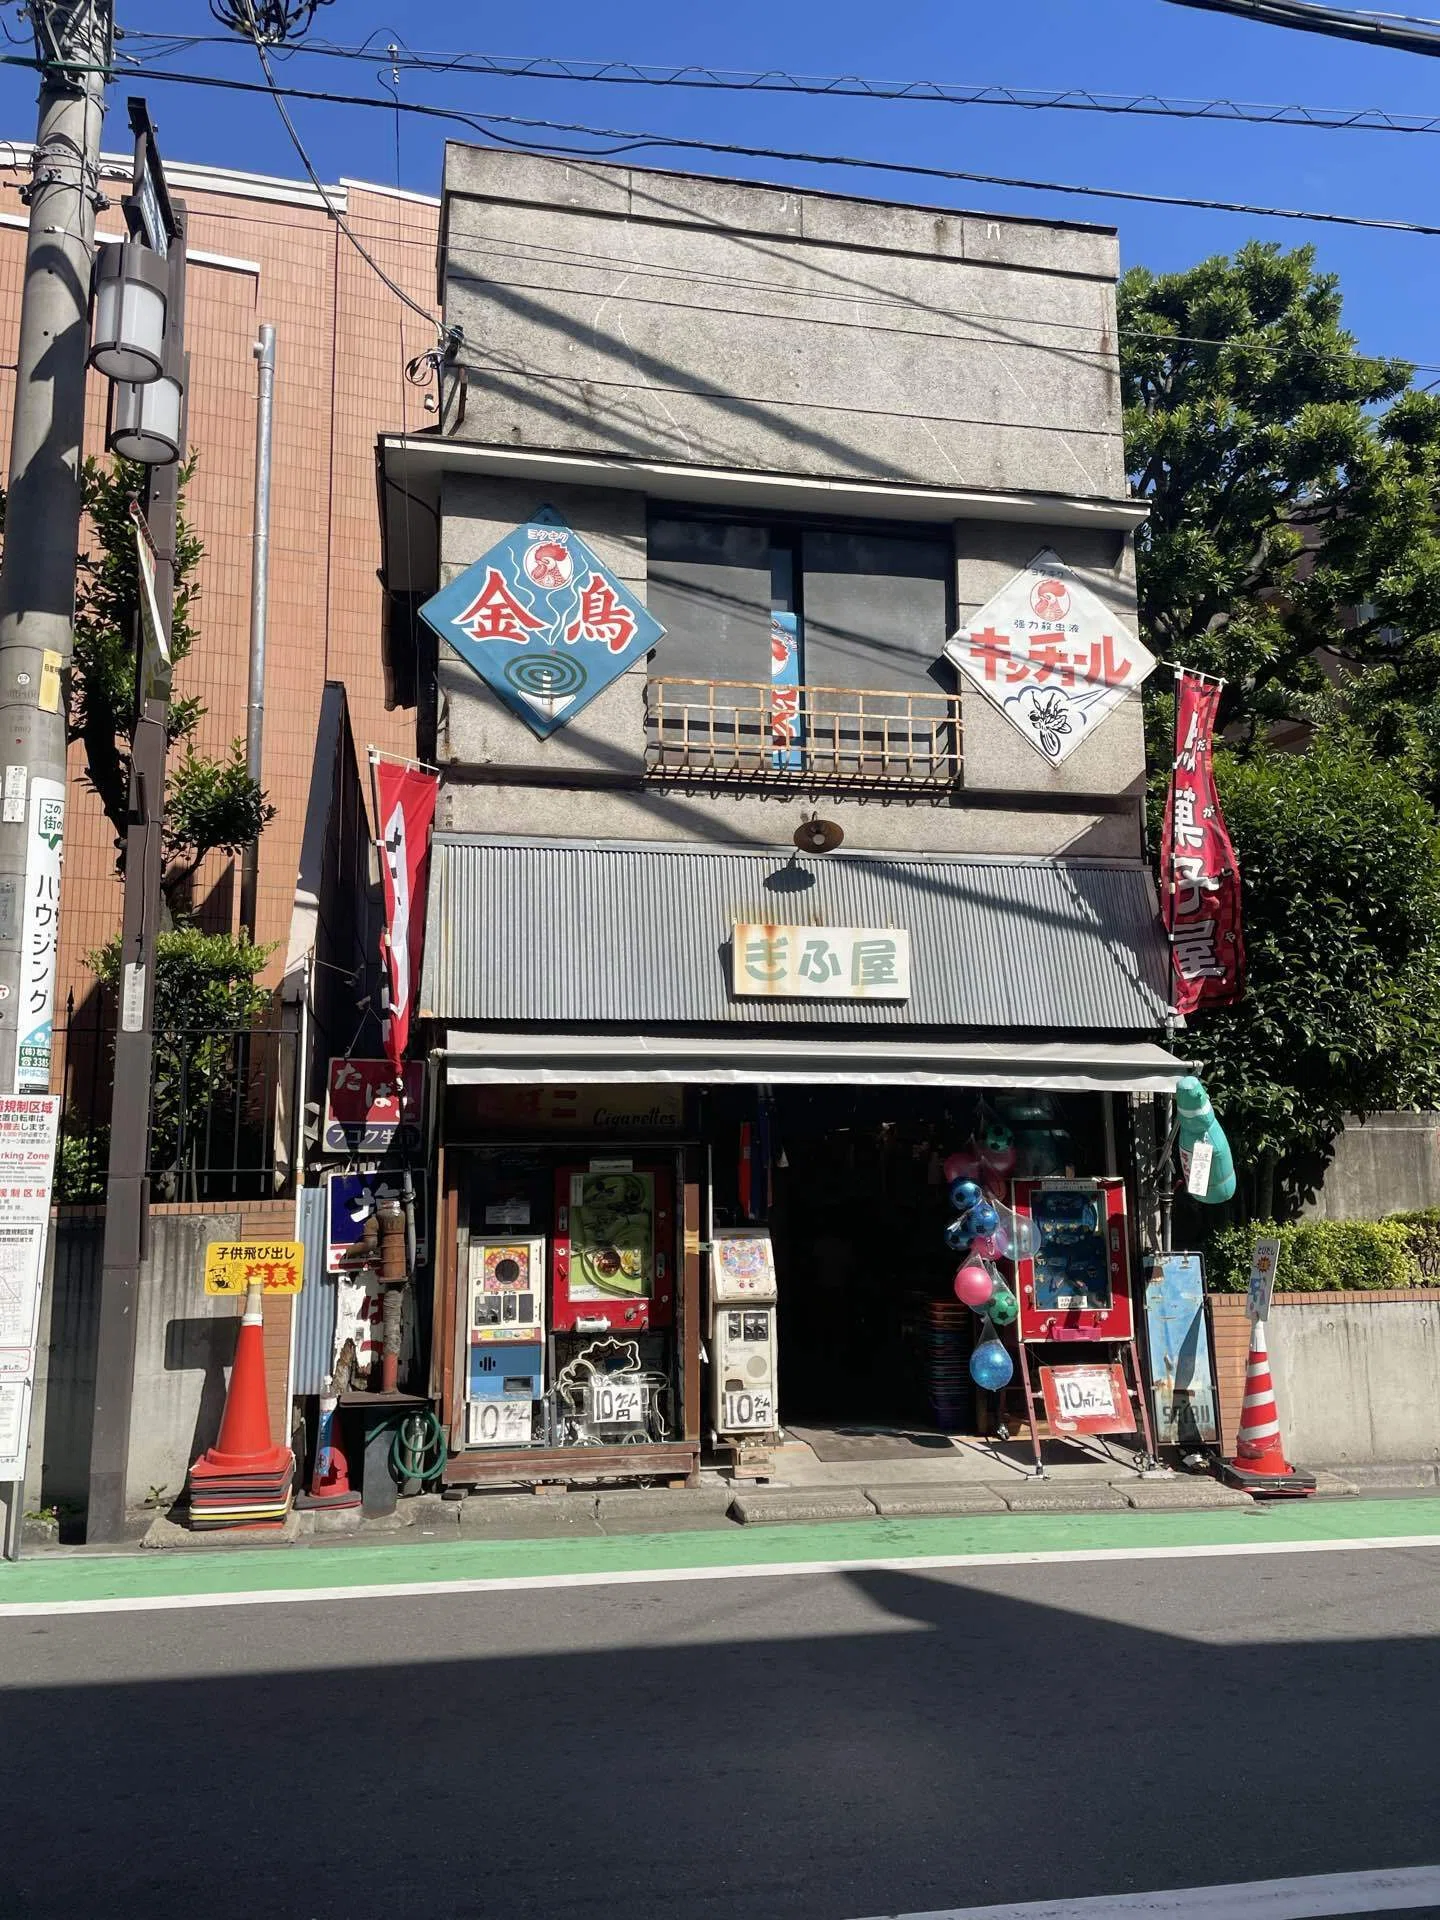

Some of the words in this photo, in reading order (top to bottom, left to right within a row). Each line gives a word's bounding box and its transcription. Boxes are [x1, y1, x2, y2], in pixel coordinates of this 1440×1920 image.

[451, 565, 639, 655] 金鳥
[1013, 618, 1080, 634] 強力殺虫液
[969, 626, 1132, 688] キンチョール
[44, 802, 62, 815] この
[30, 873, 54, 1014] ハウジング
[744, 936, 899, 986] ぎふ屋
[592, 1107, 677, 1128] Cigarettes
[27, 1151, 50, 1160] Zone
[215, 1246, 296, 1261] 子供飛び出し
[595, 1389, 614, 1421] 10
[615, 1408, 631, 1421] 円
[728, 1394, 754, 1425] 10
[754, 1410, 767, 1423] 円
[473, 1404, 500, 1440] 10
